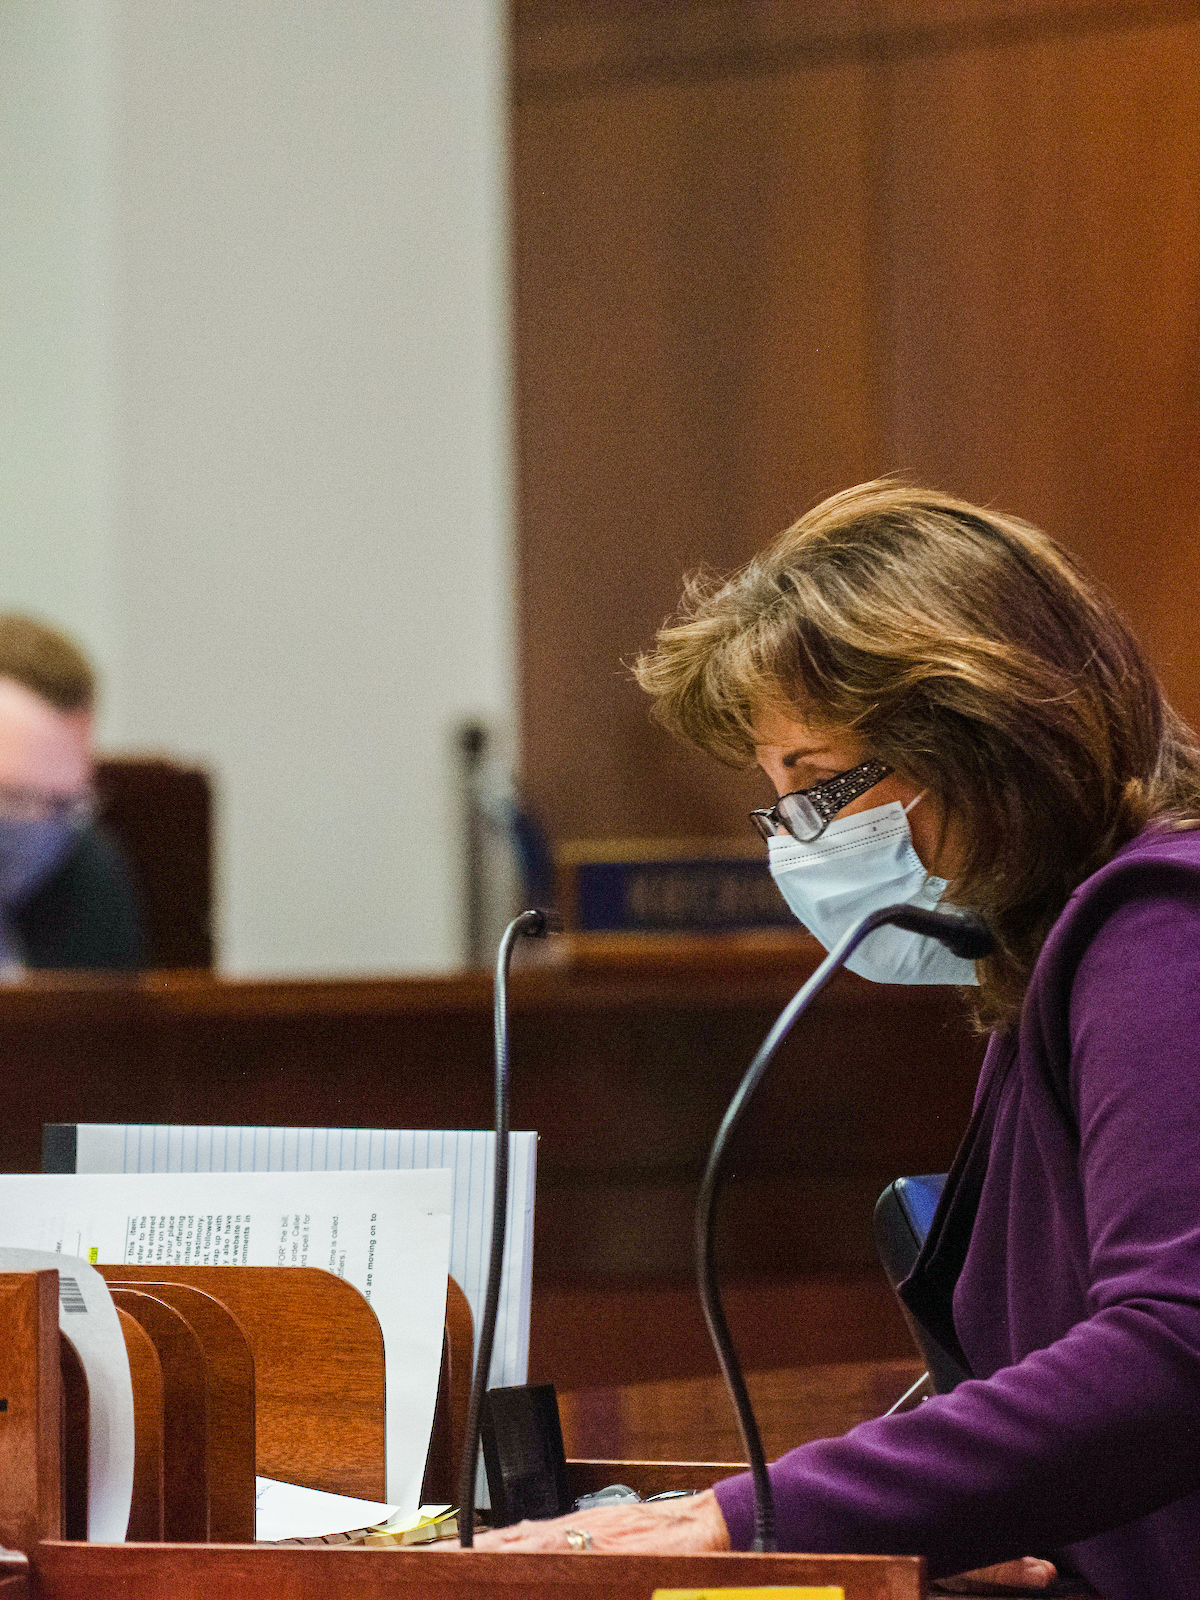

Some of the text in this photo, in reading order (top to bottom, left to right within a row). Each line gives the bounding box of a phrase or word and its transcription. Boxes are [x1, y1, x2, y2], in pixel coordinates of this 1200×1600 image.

[292, 1214, 300, 1236] Caller
[370, 1213, 377, 1221] to
[148, 1216, 156, 1246] entered
[159, 1231, 164, 1241] on
[176, 1216, 186, 1246] offering
[204, 1216, 212, 1249] followed
[370, 1225, 376, 1236] on
[215, 1235, 221, 1245] up
[146, 1249, 152, 1258] be
[156, 1244, 164, 1260] stay
[367, 1240, 376, 1270] moving
